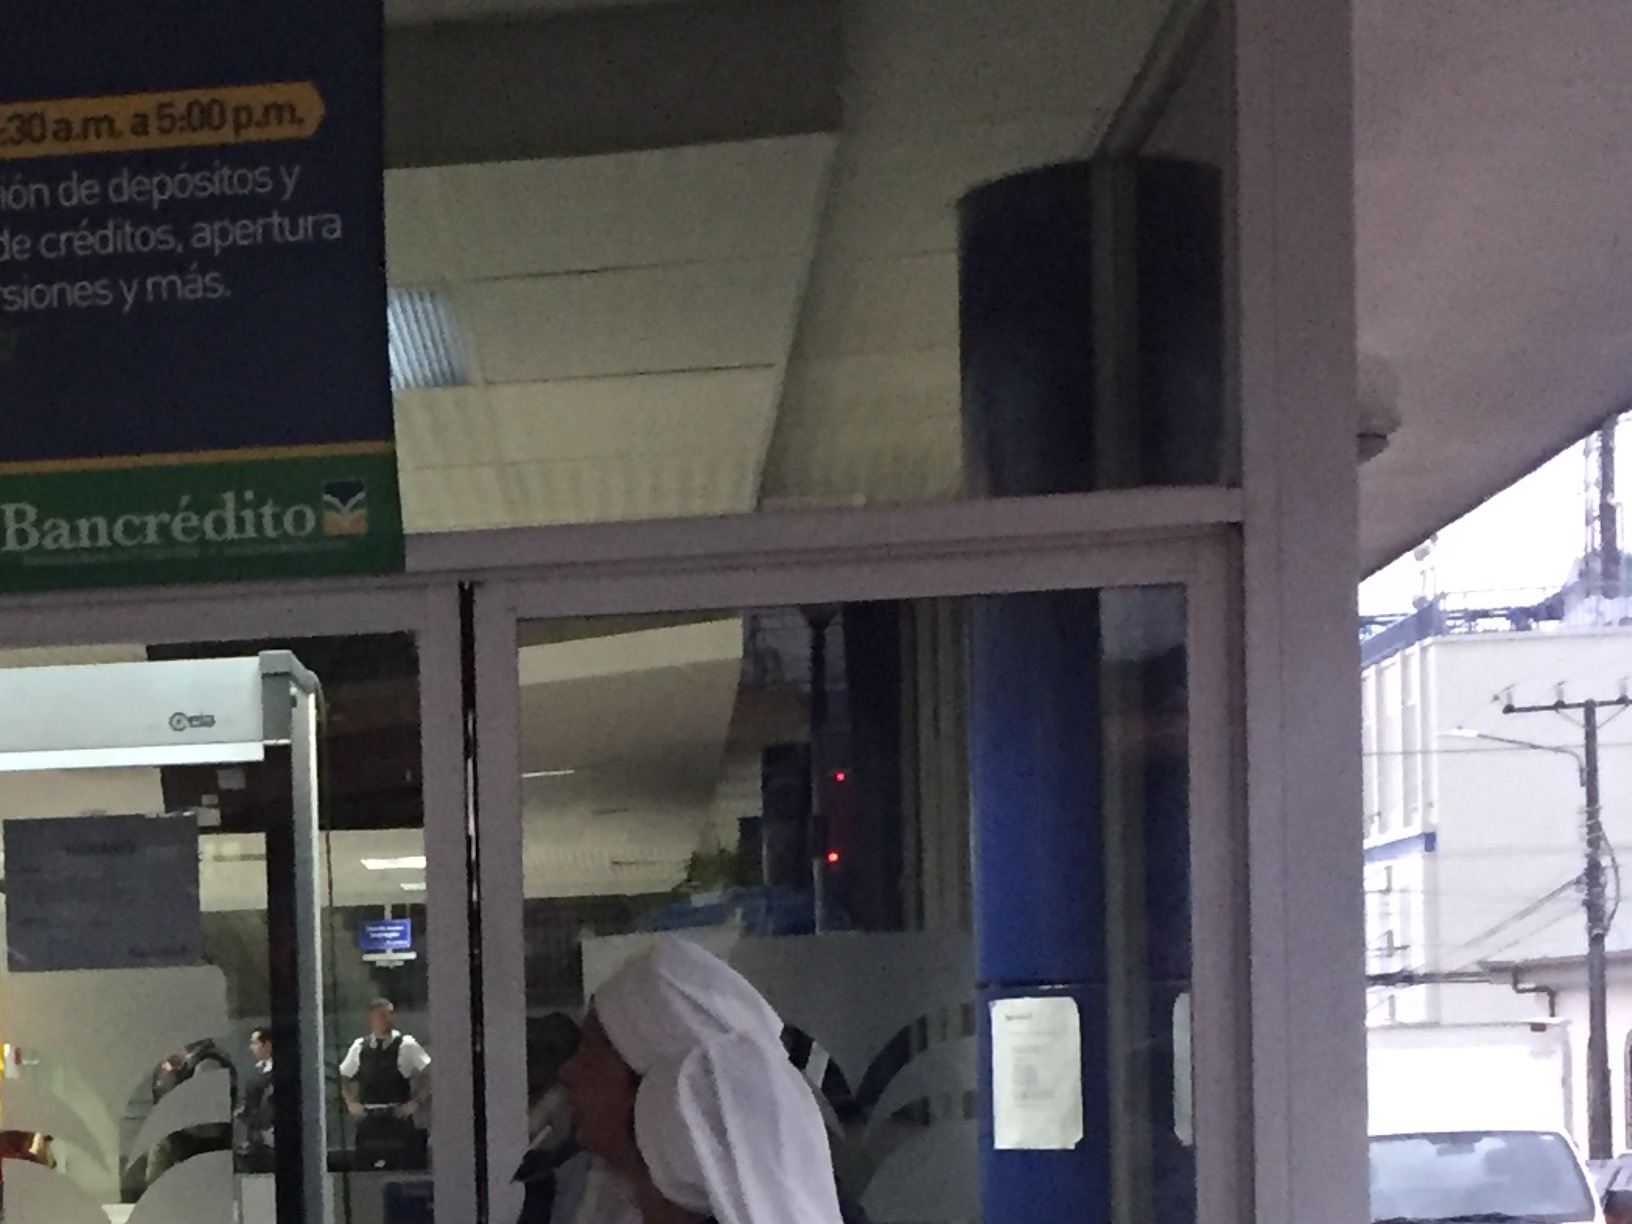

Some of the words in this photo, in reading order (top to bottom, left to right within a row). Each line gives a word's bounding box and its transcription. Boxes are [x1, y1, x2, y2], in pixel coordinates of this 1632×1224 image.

[52, 113, 124, 142] a.m.
[130, 111, 150, 137] a
[155, 97, 226, 135] 5:00
[231, 100, 306, 137] p.m.
[56, 169, 101, 207] de
[108, 159, 274, 211] depósitos
[279, 164, 301, 201] y
[38, 216, 184, 259] créditos,
[190, 209, 343, 257] apertura
[118, 278, 139, 315] y
[146, 261, 232, 302] más.
[0, 489, 317, 553] Bancrédito
